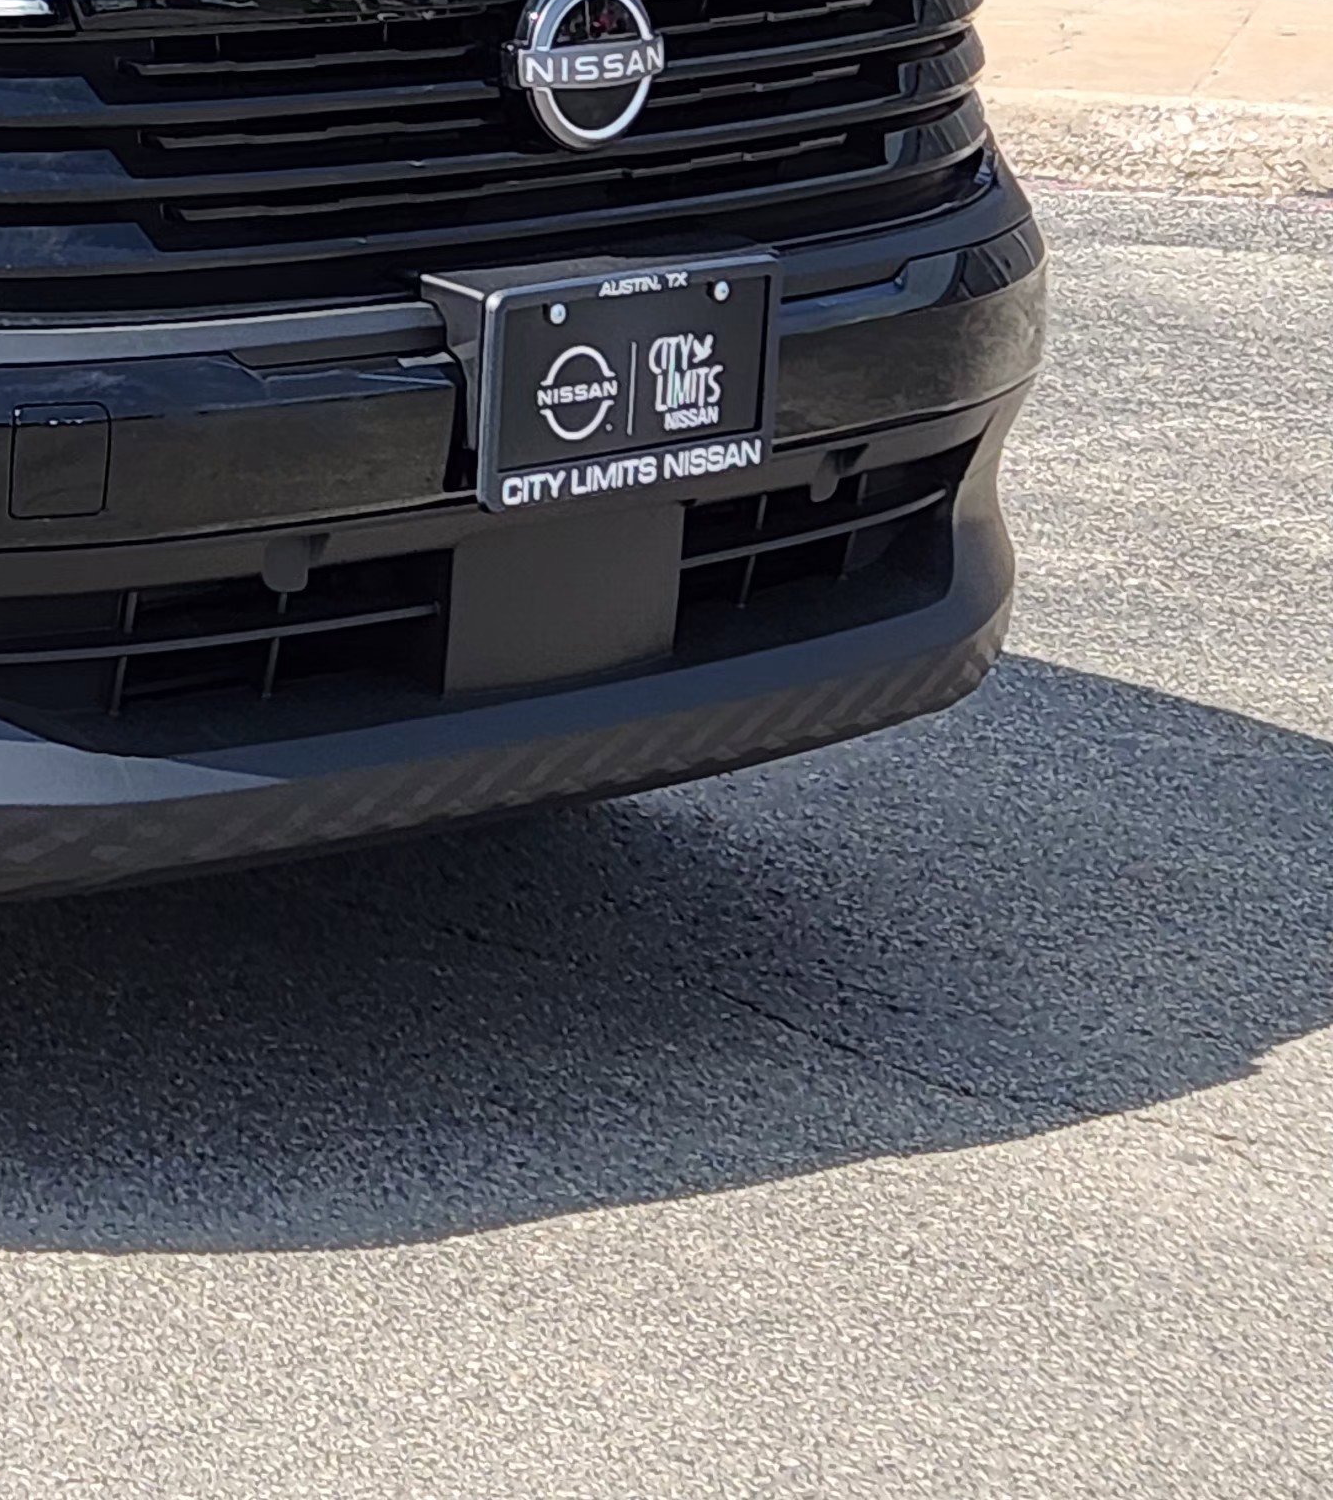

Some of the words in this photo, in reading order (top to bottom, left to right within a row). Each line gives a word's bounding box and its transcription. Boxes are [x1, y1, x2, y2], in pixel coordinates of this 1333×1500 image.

[524, 43, 662, 83] NISSAN
[664, 272, 688, 288] TX
[648, 333, 694, 375] CITY
[536, 379, 619, 407] NISSAN
[654, 364, 724, 412] LIMITS
[663, 405, 719, 432] NISSAN
[501, 470, 567, 507] CITY
[570, 456, 658, 496] LIMITS
[662, 439, 762, 481] NISSAN
